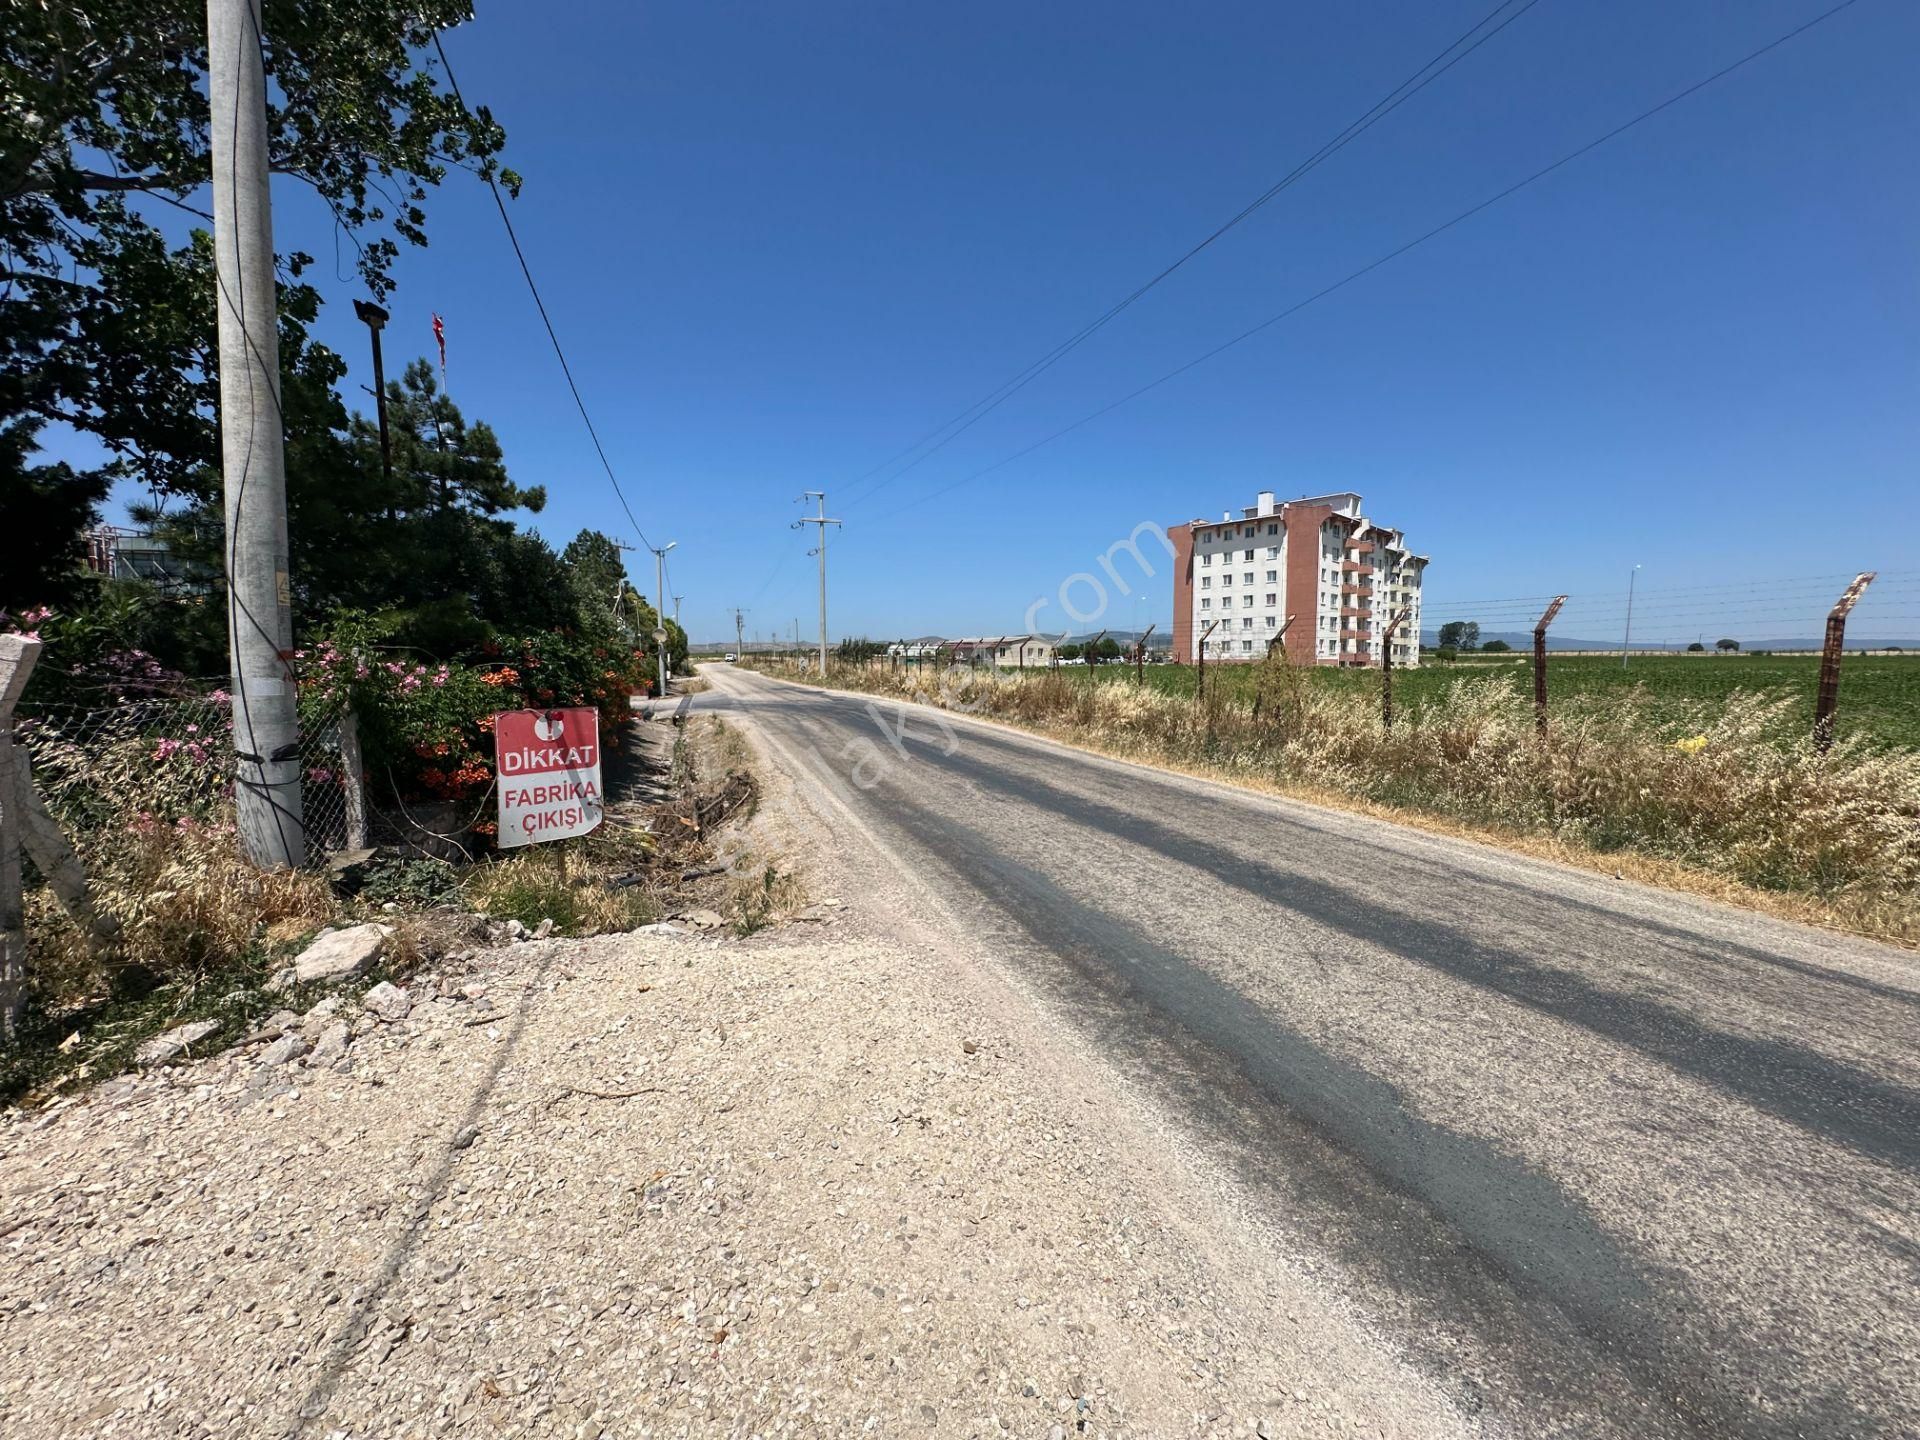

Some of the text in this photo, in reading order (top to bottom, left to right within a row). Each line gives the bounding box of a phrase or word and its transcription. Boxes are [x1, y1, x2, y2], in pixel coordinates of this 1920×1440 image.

[505, 746, 594, 771] DİKKAT
[505, 781, 596, 808] FABRİKA
[522, 807, 583, 836] ÇIKIŞI
